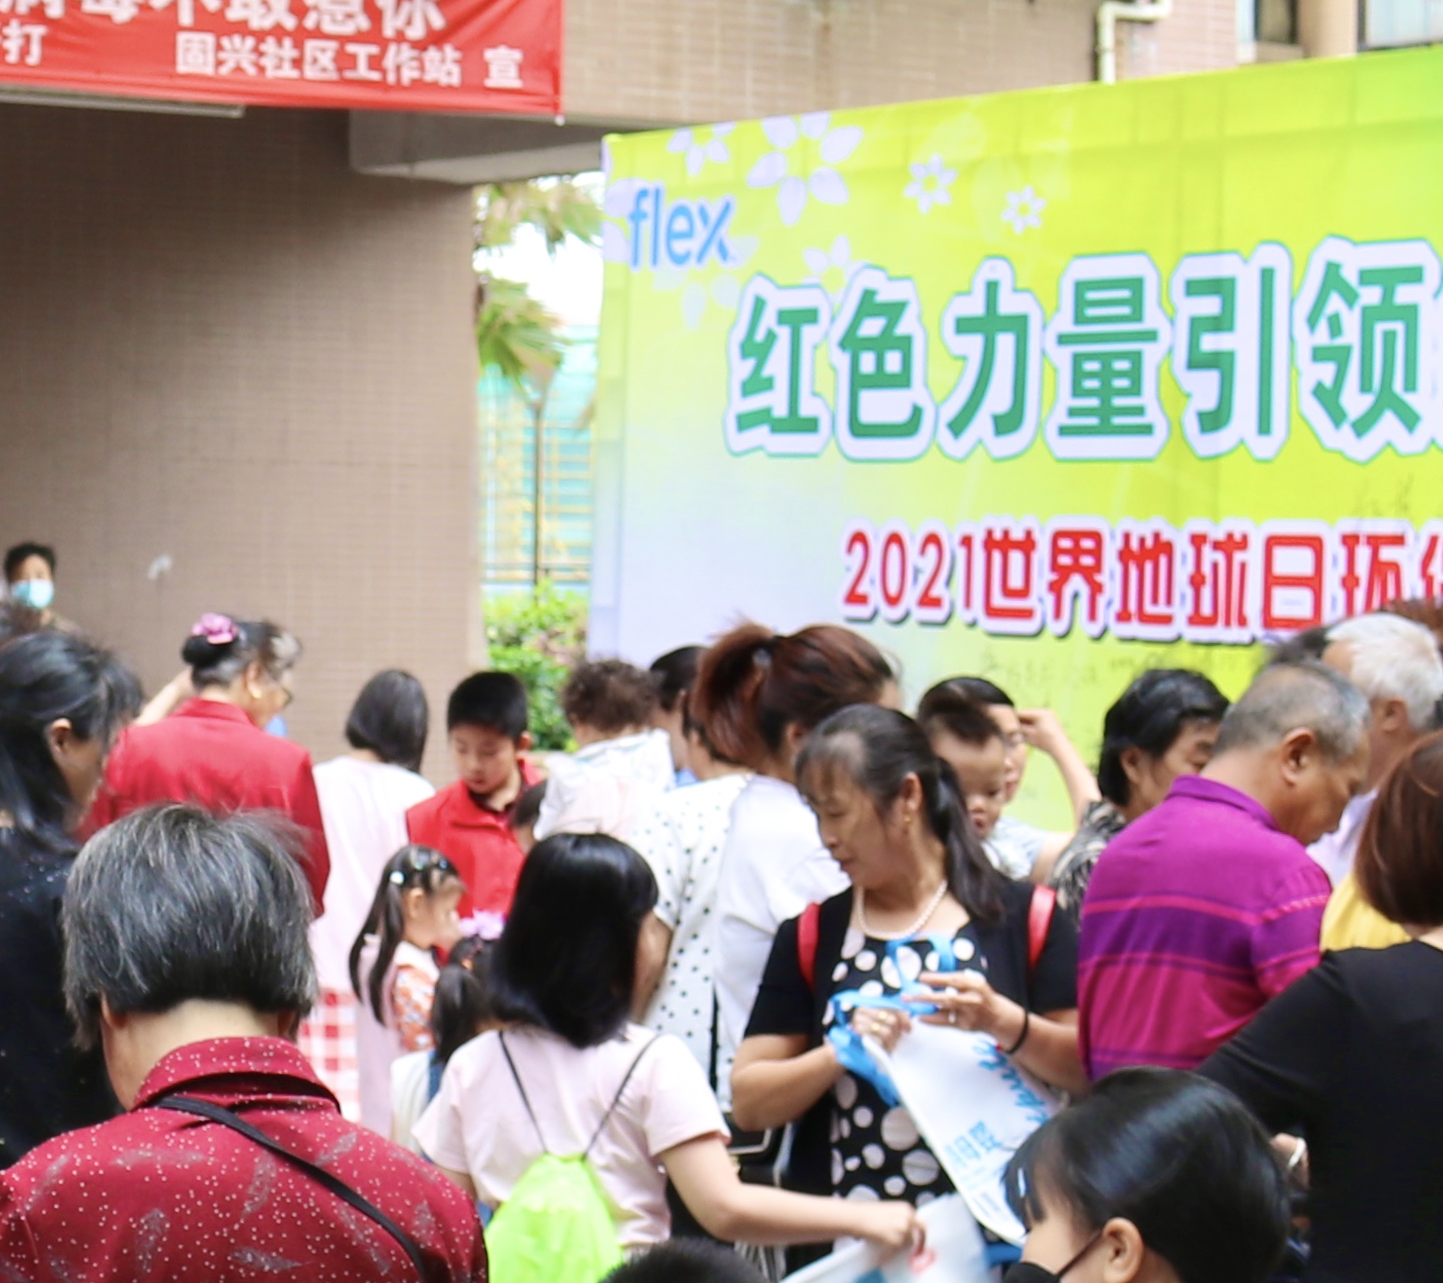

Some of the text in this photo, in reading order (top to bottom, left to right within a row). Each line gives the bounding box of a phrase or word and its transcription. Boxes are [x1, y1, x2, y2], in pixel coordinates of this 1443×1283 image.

[175, 31, 525, 89] 固兴社区工作站 宣
[627, 187, 735, 267] flex
